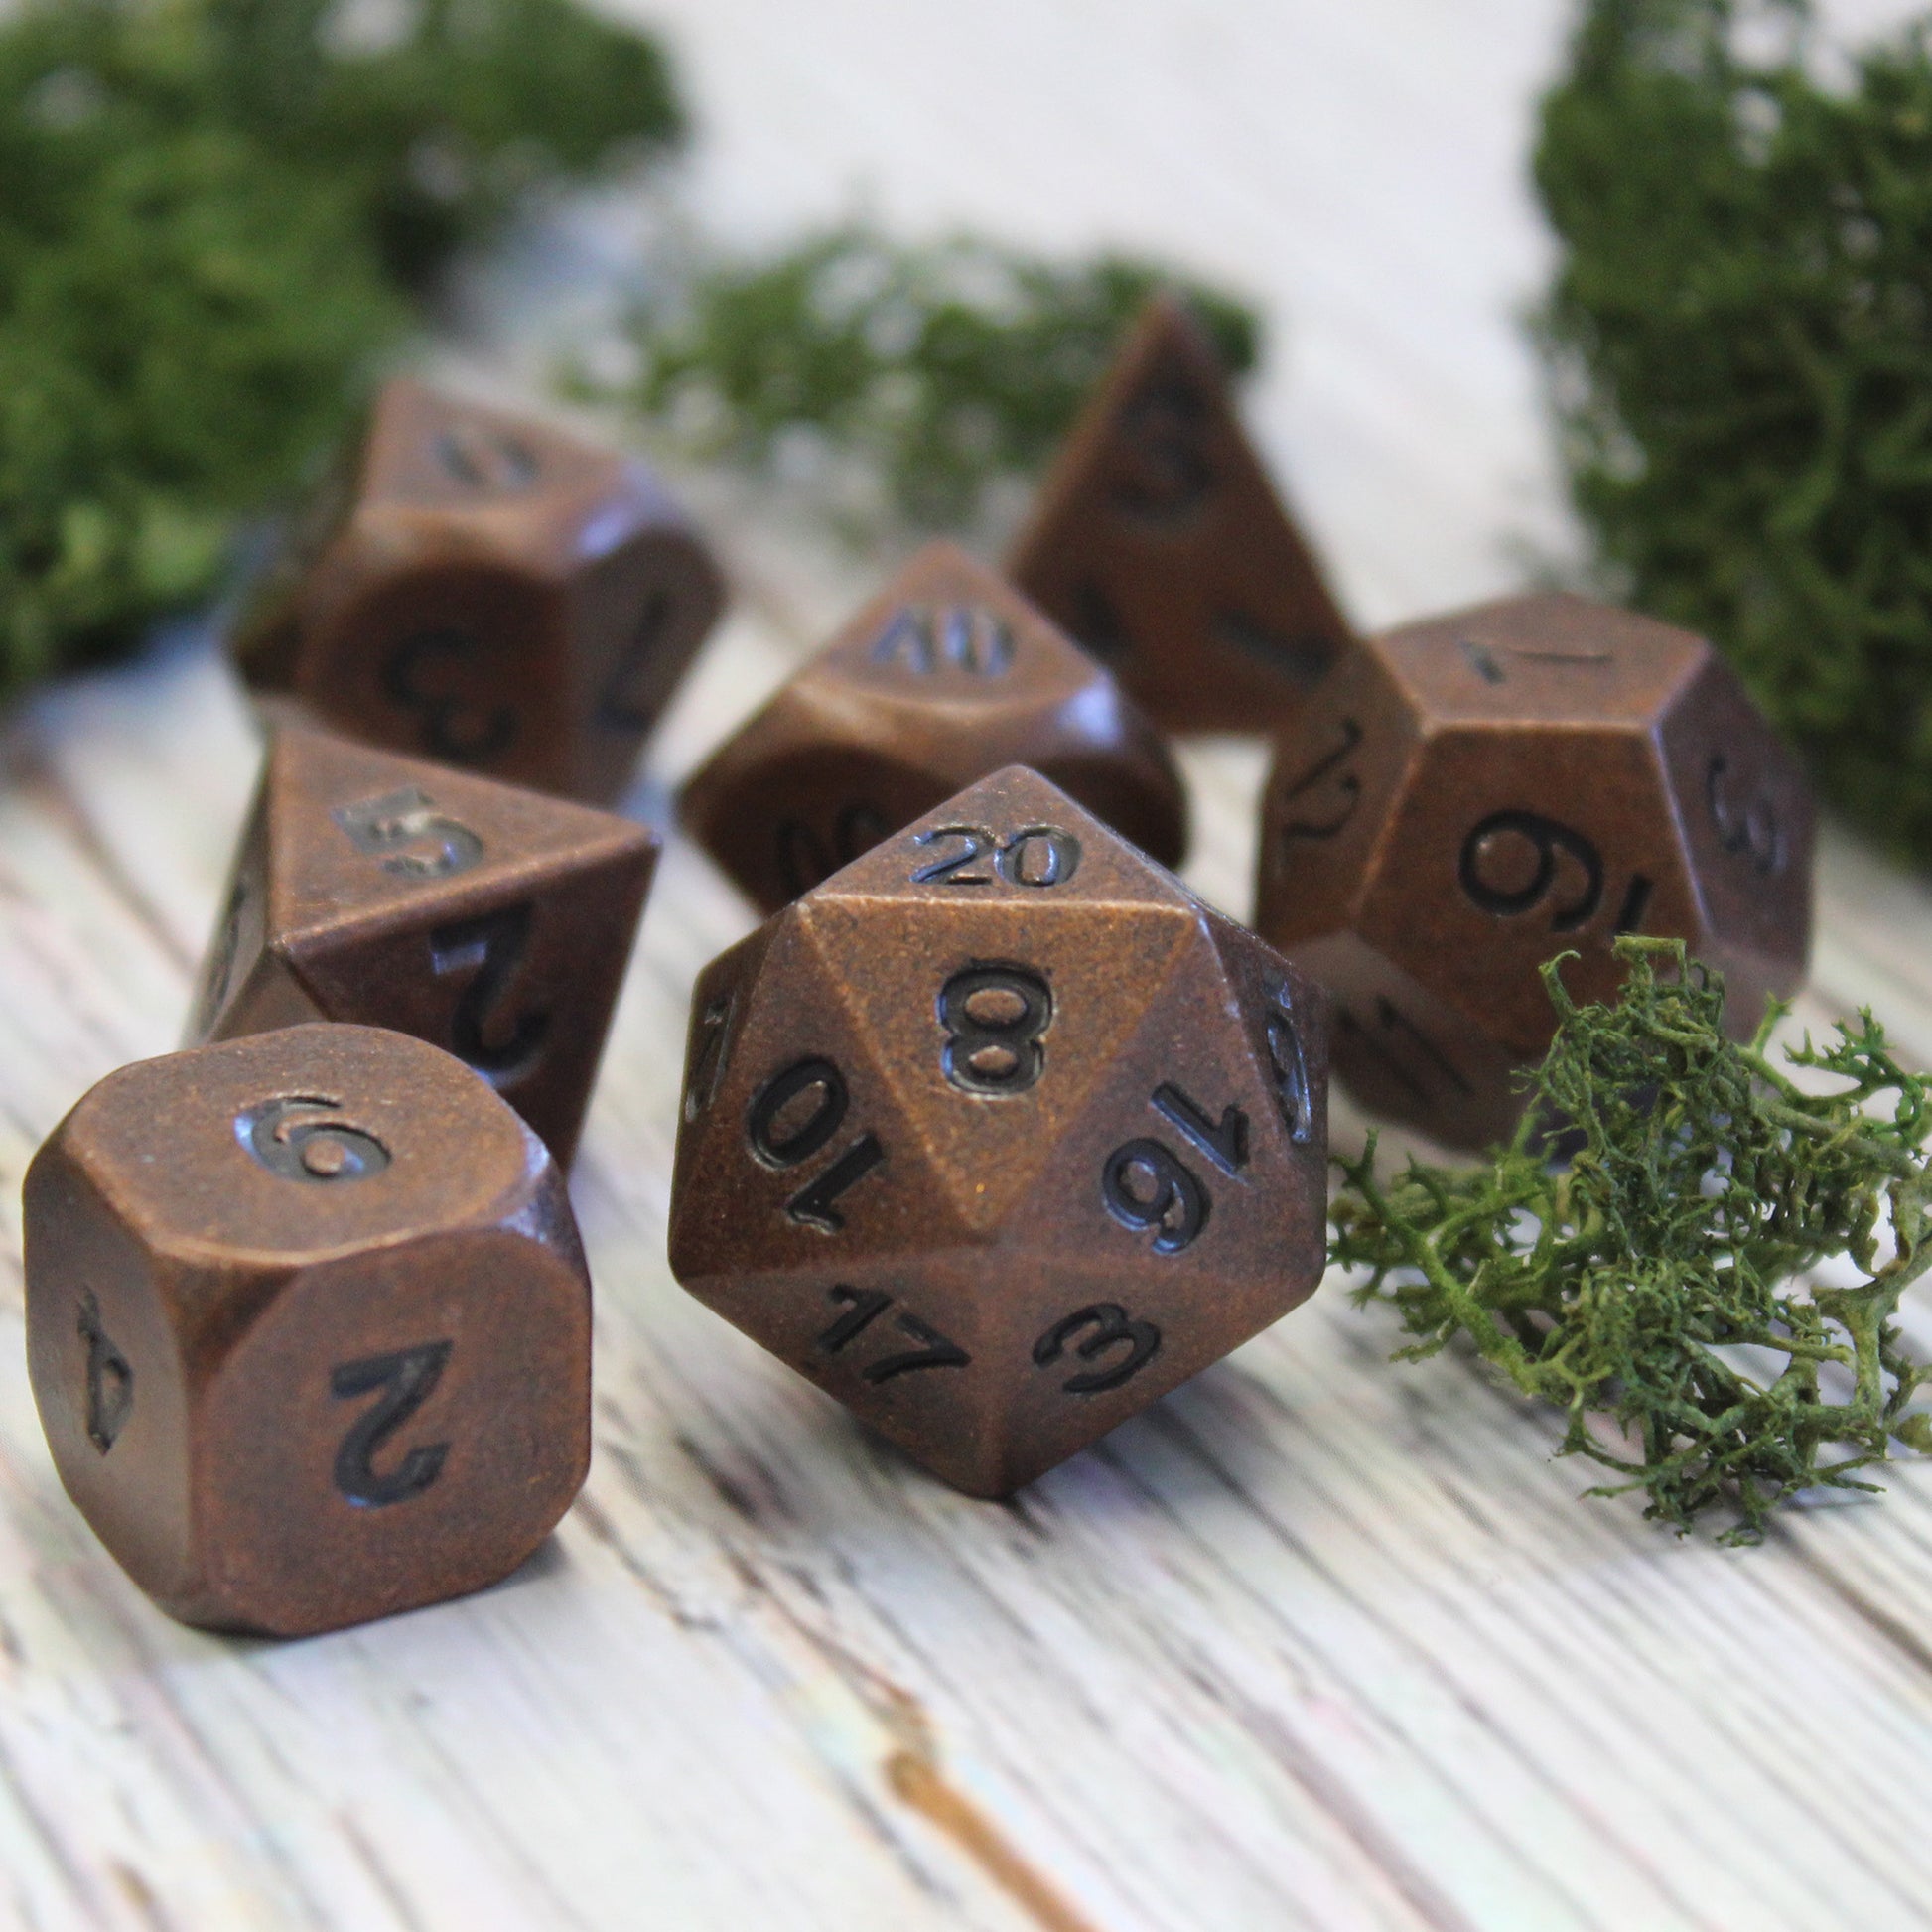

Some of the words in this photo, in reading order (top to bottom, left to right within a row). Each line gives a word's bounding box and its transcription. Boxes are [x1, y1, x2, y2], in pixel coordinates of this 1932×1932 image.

[331, 787, 484, 880] 5
[909, 825, 1083, 888] 20
[936, 959, 1054, 1096] 8
[234, 1093, 393, 1182] 6
[746, 1054, 885, 1235] 10
[1102, 1080, 1251, 1256] 16
[816, 1282, 972, 1386] 17
[1031, 1300, 1163, 1396] 3
[330, 1338, 455, 1510] 2
